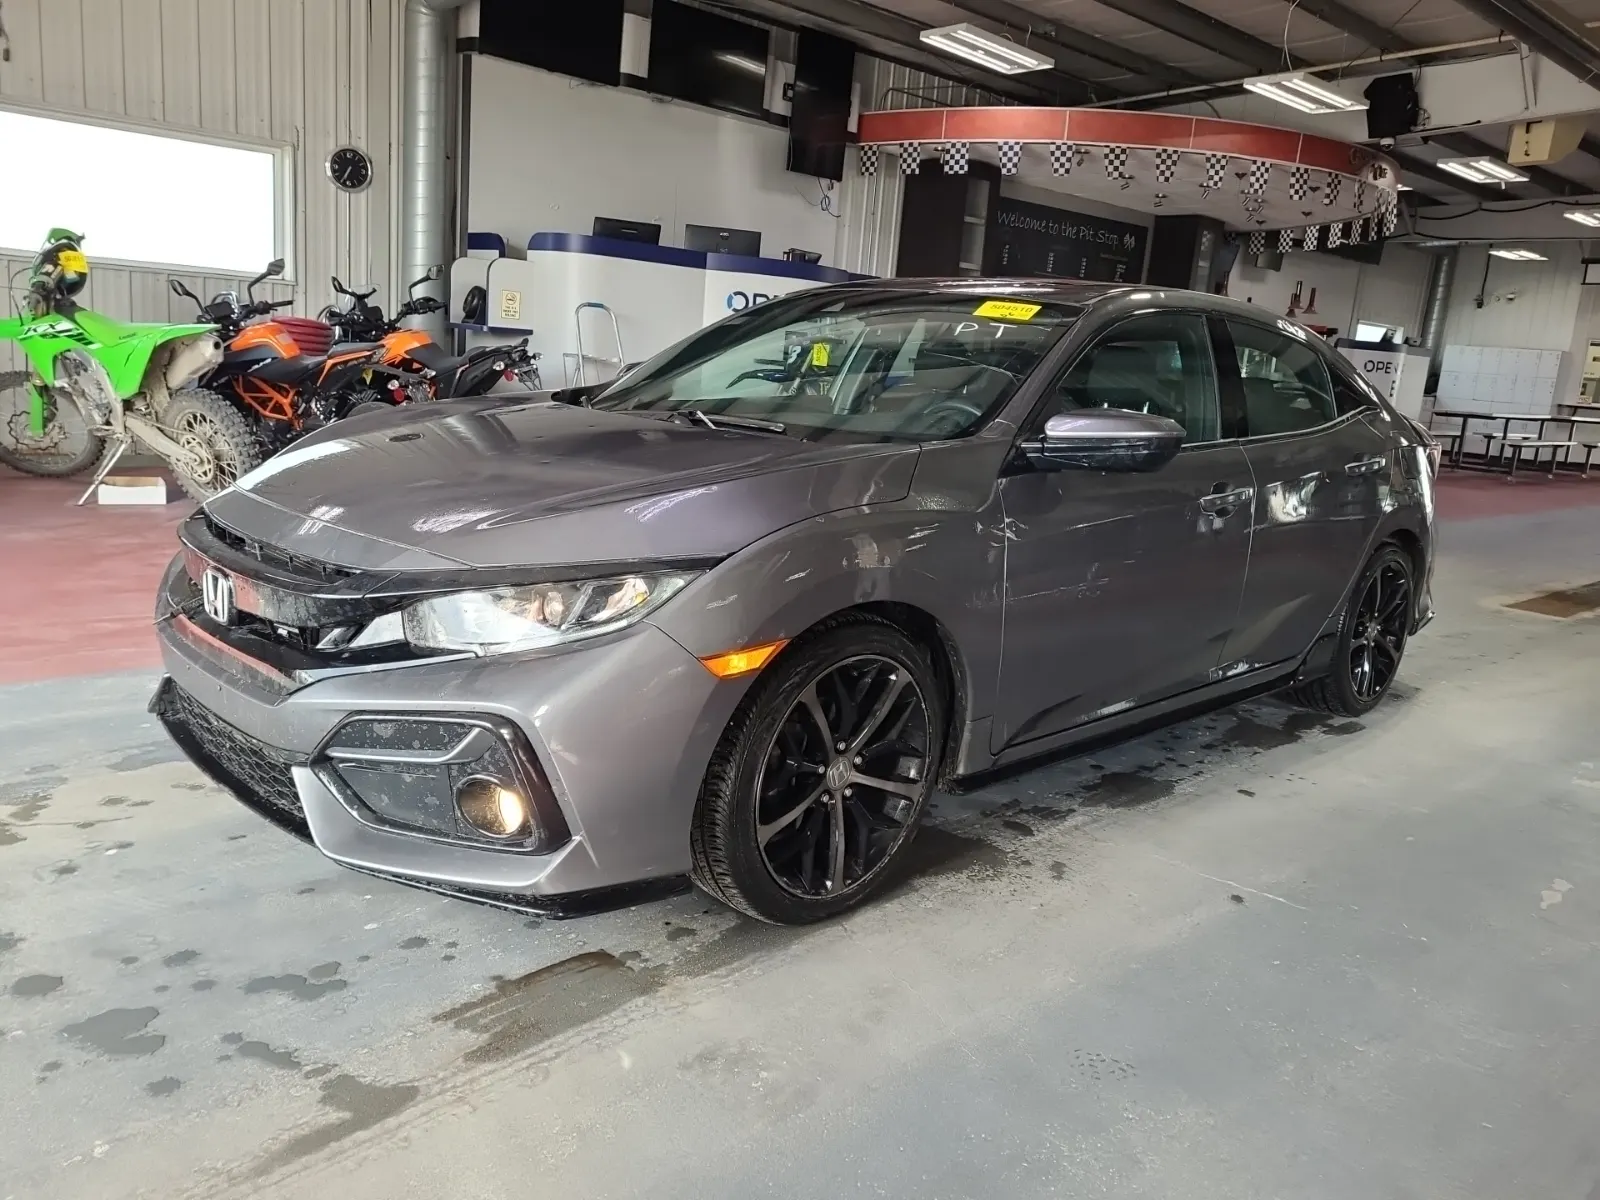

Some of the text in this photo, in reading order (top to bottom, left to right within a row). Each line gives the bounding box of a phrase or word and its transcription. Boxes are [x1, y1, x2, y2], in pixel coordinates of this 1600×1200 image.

[997, 210, 1119, 251] Welcome to the Pit Stop
[954, 321, 1018, 338] P T
